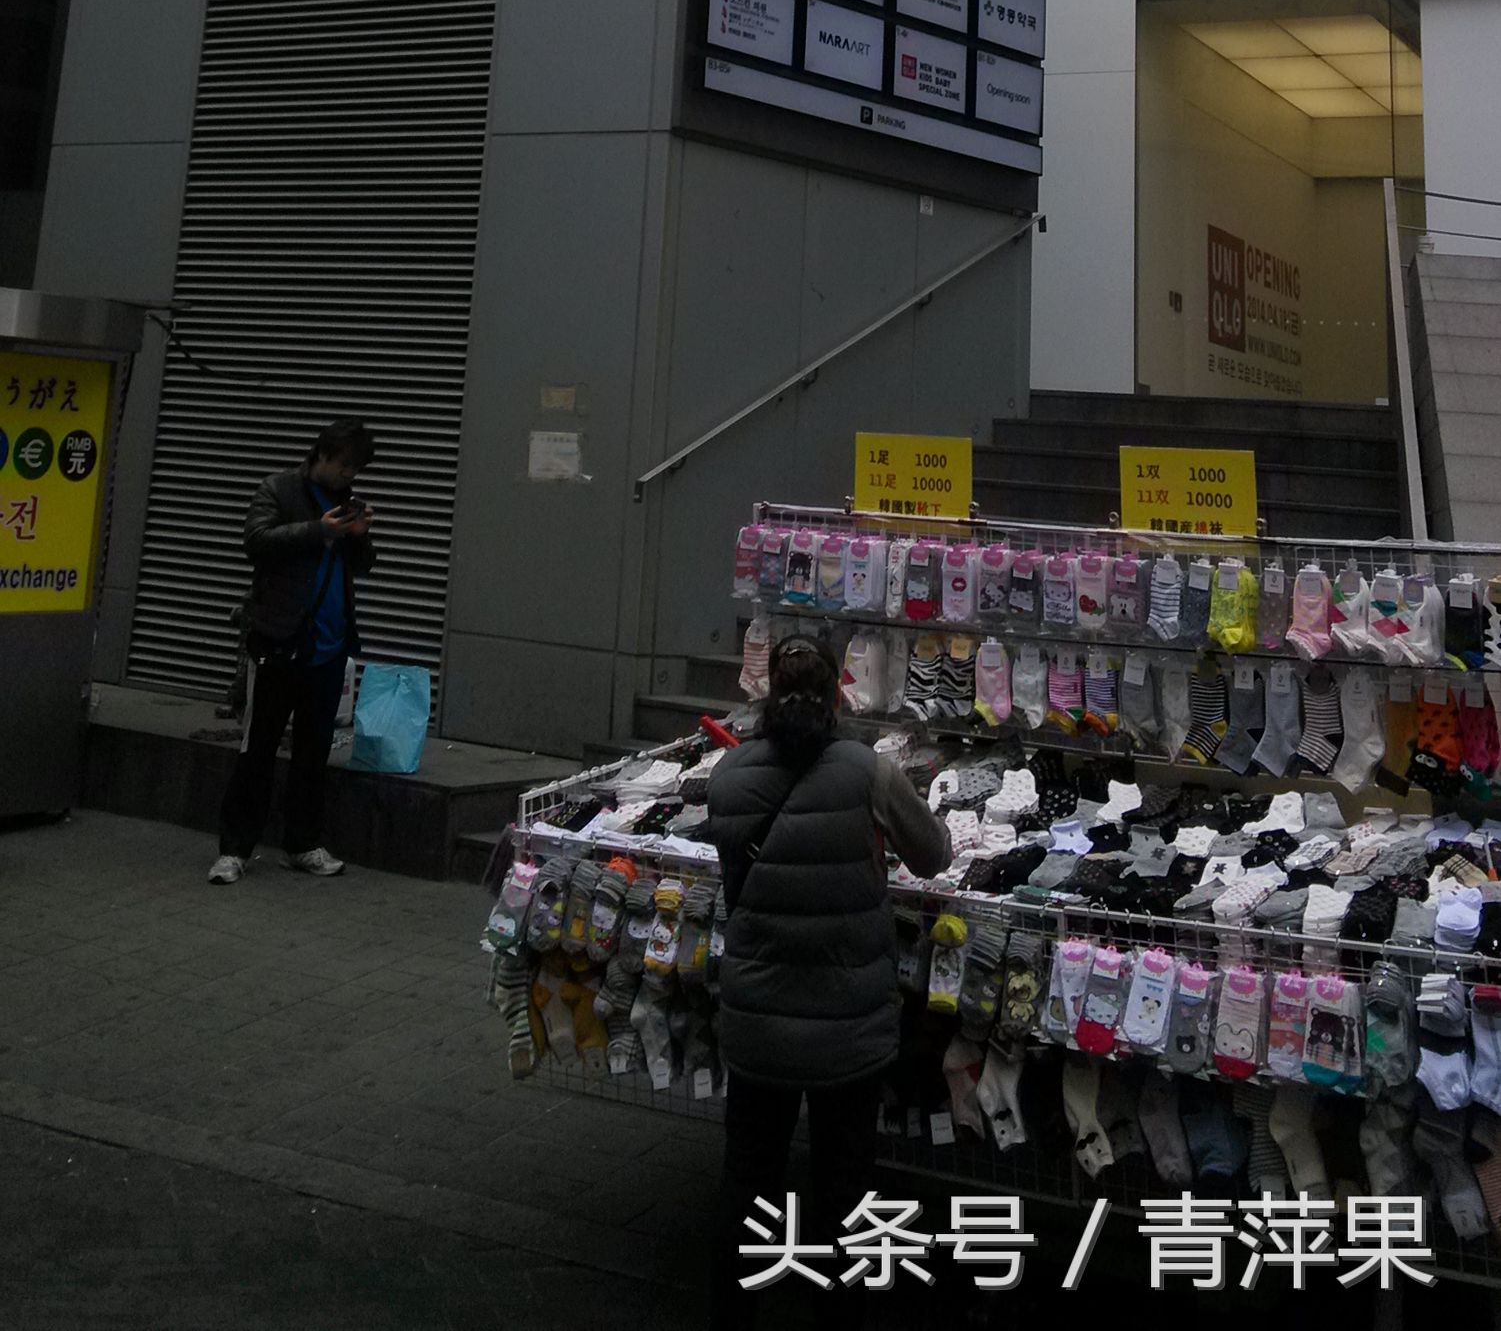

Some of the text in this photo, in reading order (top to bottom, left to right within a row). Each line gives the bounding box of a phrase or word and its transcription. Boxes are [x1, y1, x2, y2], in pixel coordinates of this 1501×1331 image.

[919, 73, 950, 87] KIDS BABY
[919, 83, 960, 101] SPECIAL ZONE
[877, 114, 906, 130] PARKING
[1246, 243, 1300, 301] OPENING
[65, 435, 92, 452] RMB
[68, 452, 85, 475] 元
[915, 453, 947, 468] 1000
[1189, 467, 1226, 483] 1000
[912, 476, 952, 492] 10000
[1186, 491, 1233, 509] 10000
[0, 495, 38, 541] 전
